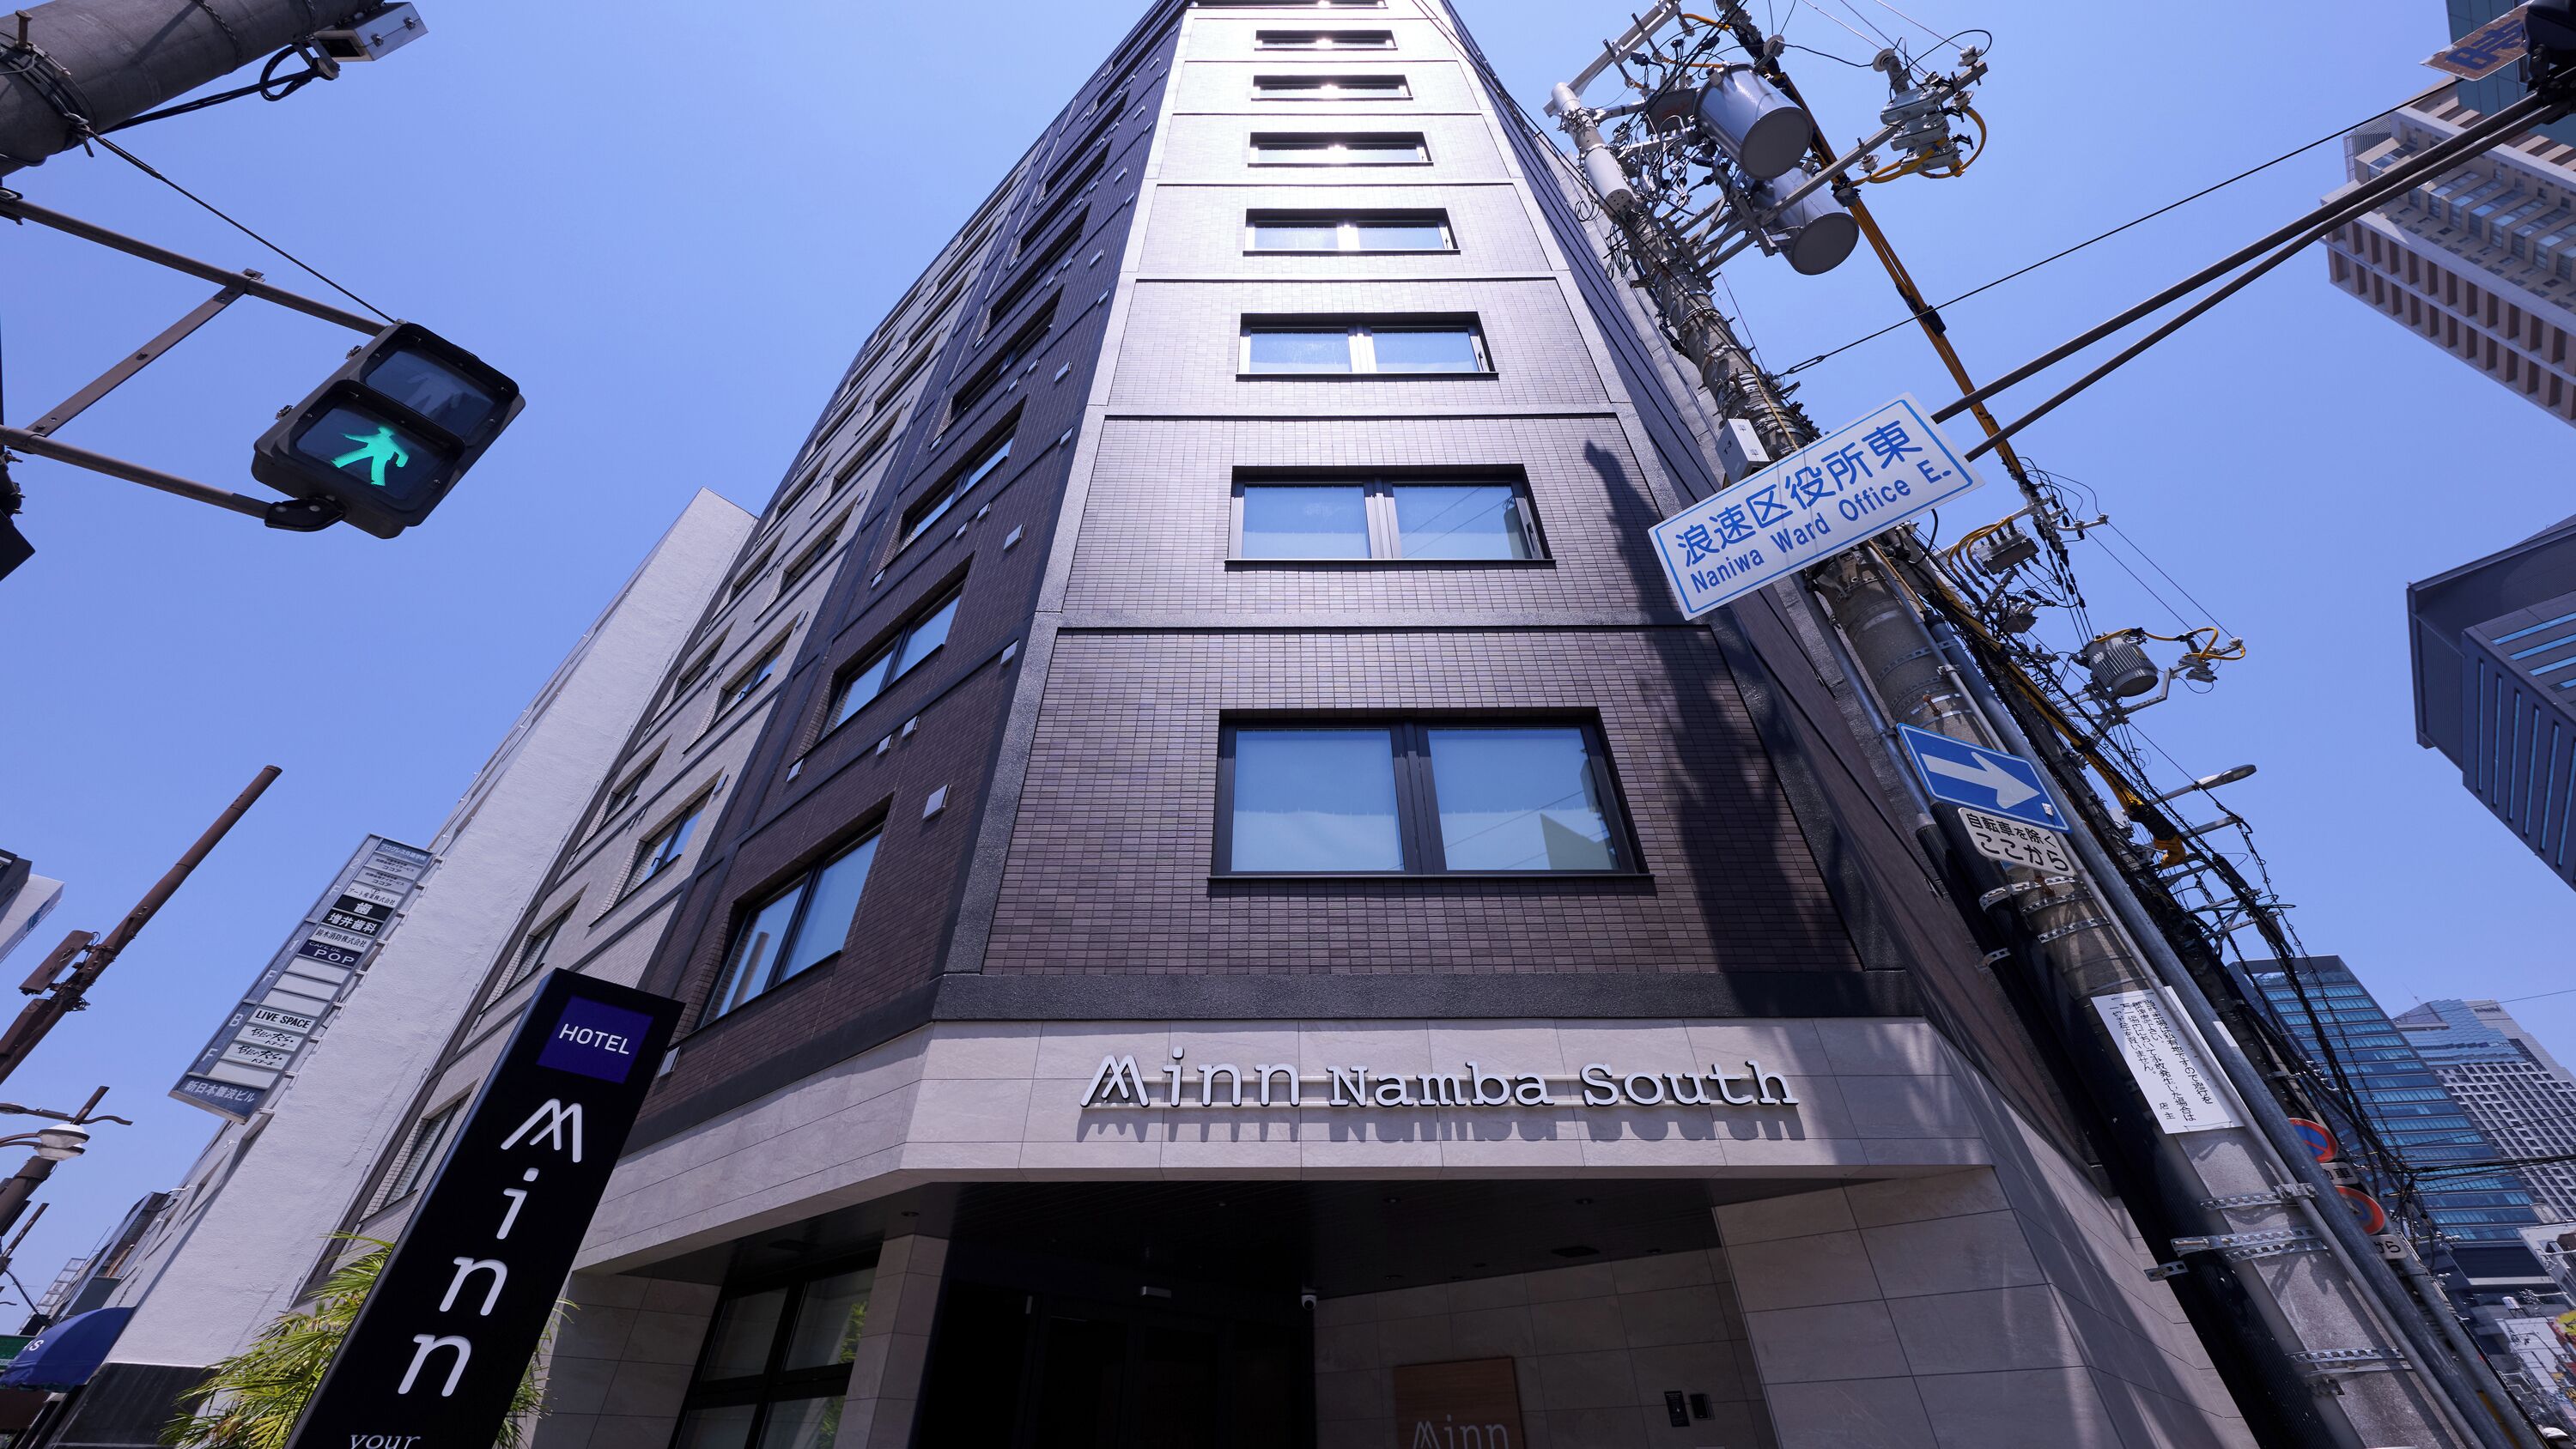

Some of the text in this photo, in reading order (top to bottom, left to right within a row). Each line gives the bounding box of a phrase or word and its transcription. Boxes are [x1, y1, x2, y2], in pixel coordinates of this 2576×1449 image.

[1676, 420, 1923, 567] 浪速区役所東
[1691, 459, 1953, 593] Naniwa Ward Office E.
[1966, 813, 2057, 848] 自転車を除く
[1976, 832, 2069, 871] ここから
[328, 912, 377, 934] 増井歯科
[354, 902, 373, 915] 歯
[313, 949, 355, 964] POP
[255, 1009, 311, 1029] LIVE SPACE
[558, 1023, 630, 1056] HOTEL
[185, 1080, 255, 1103] 新日本難波ビル
[1079, 1046, 1801, 1109] Minn Namba South
[398, 1097, 584, 1397] Minn
[350, 1434, 422, 1449] your
